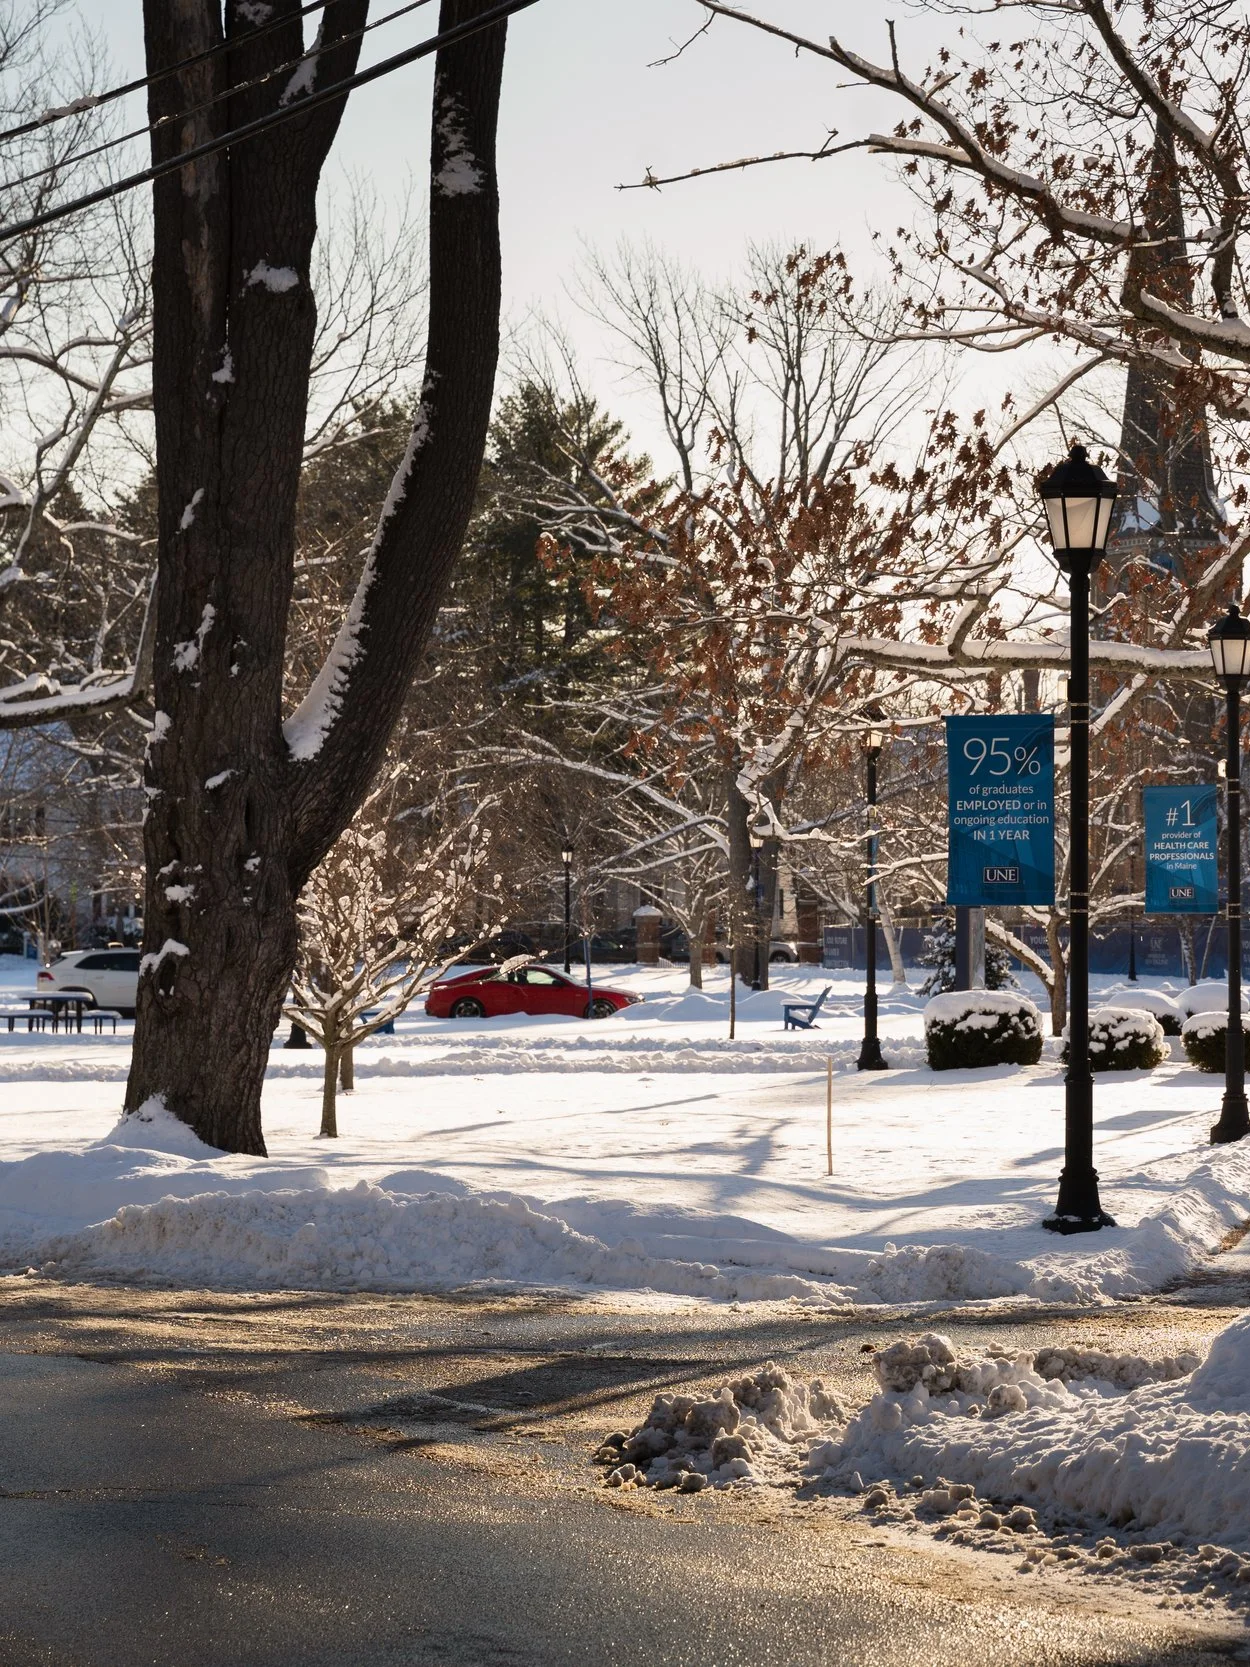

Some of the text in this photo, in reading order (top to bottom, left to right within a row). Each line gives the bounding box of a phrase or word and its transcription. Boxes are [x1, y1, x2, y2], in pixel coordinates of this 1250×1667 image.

[963, 737, 1041, 776] 95%
[969, 784, 1034, 796] of graduates
[956, 799, 1047, 811] EMPLOYED or in
[1165, 799, 1196, 827] #1
[953, 813, 1050, 827] ongoing education
[973, 830, 1030, 841] IN 1 YEAR
[1161, 831, 1202, 840] provider of
[1154, 841, 1209, 850] HEALTH CARE
[1149, 852, 1215, 861] PROFESSIONALS
[1166, 862, 1198, 870] in Maine
[986, 869, 1017, 881] UNE
[1171, 888, 1192, 897] UNE
